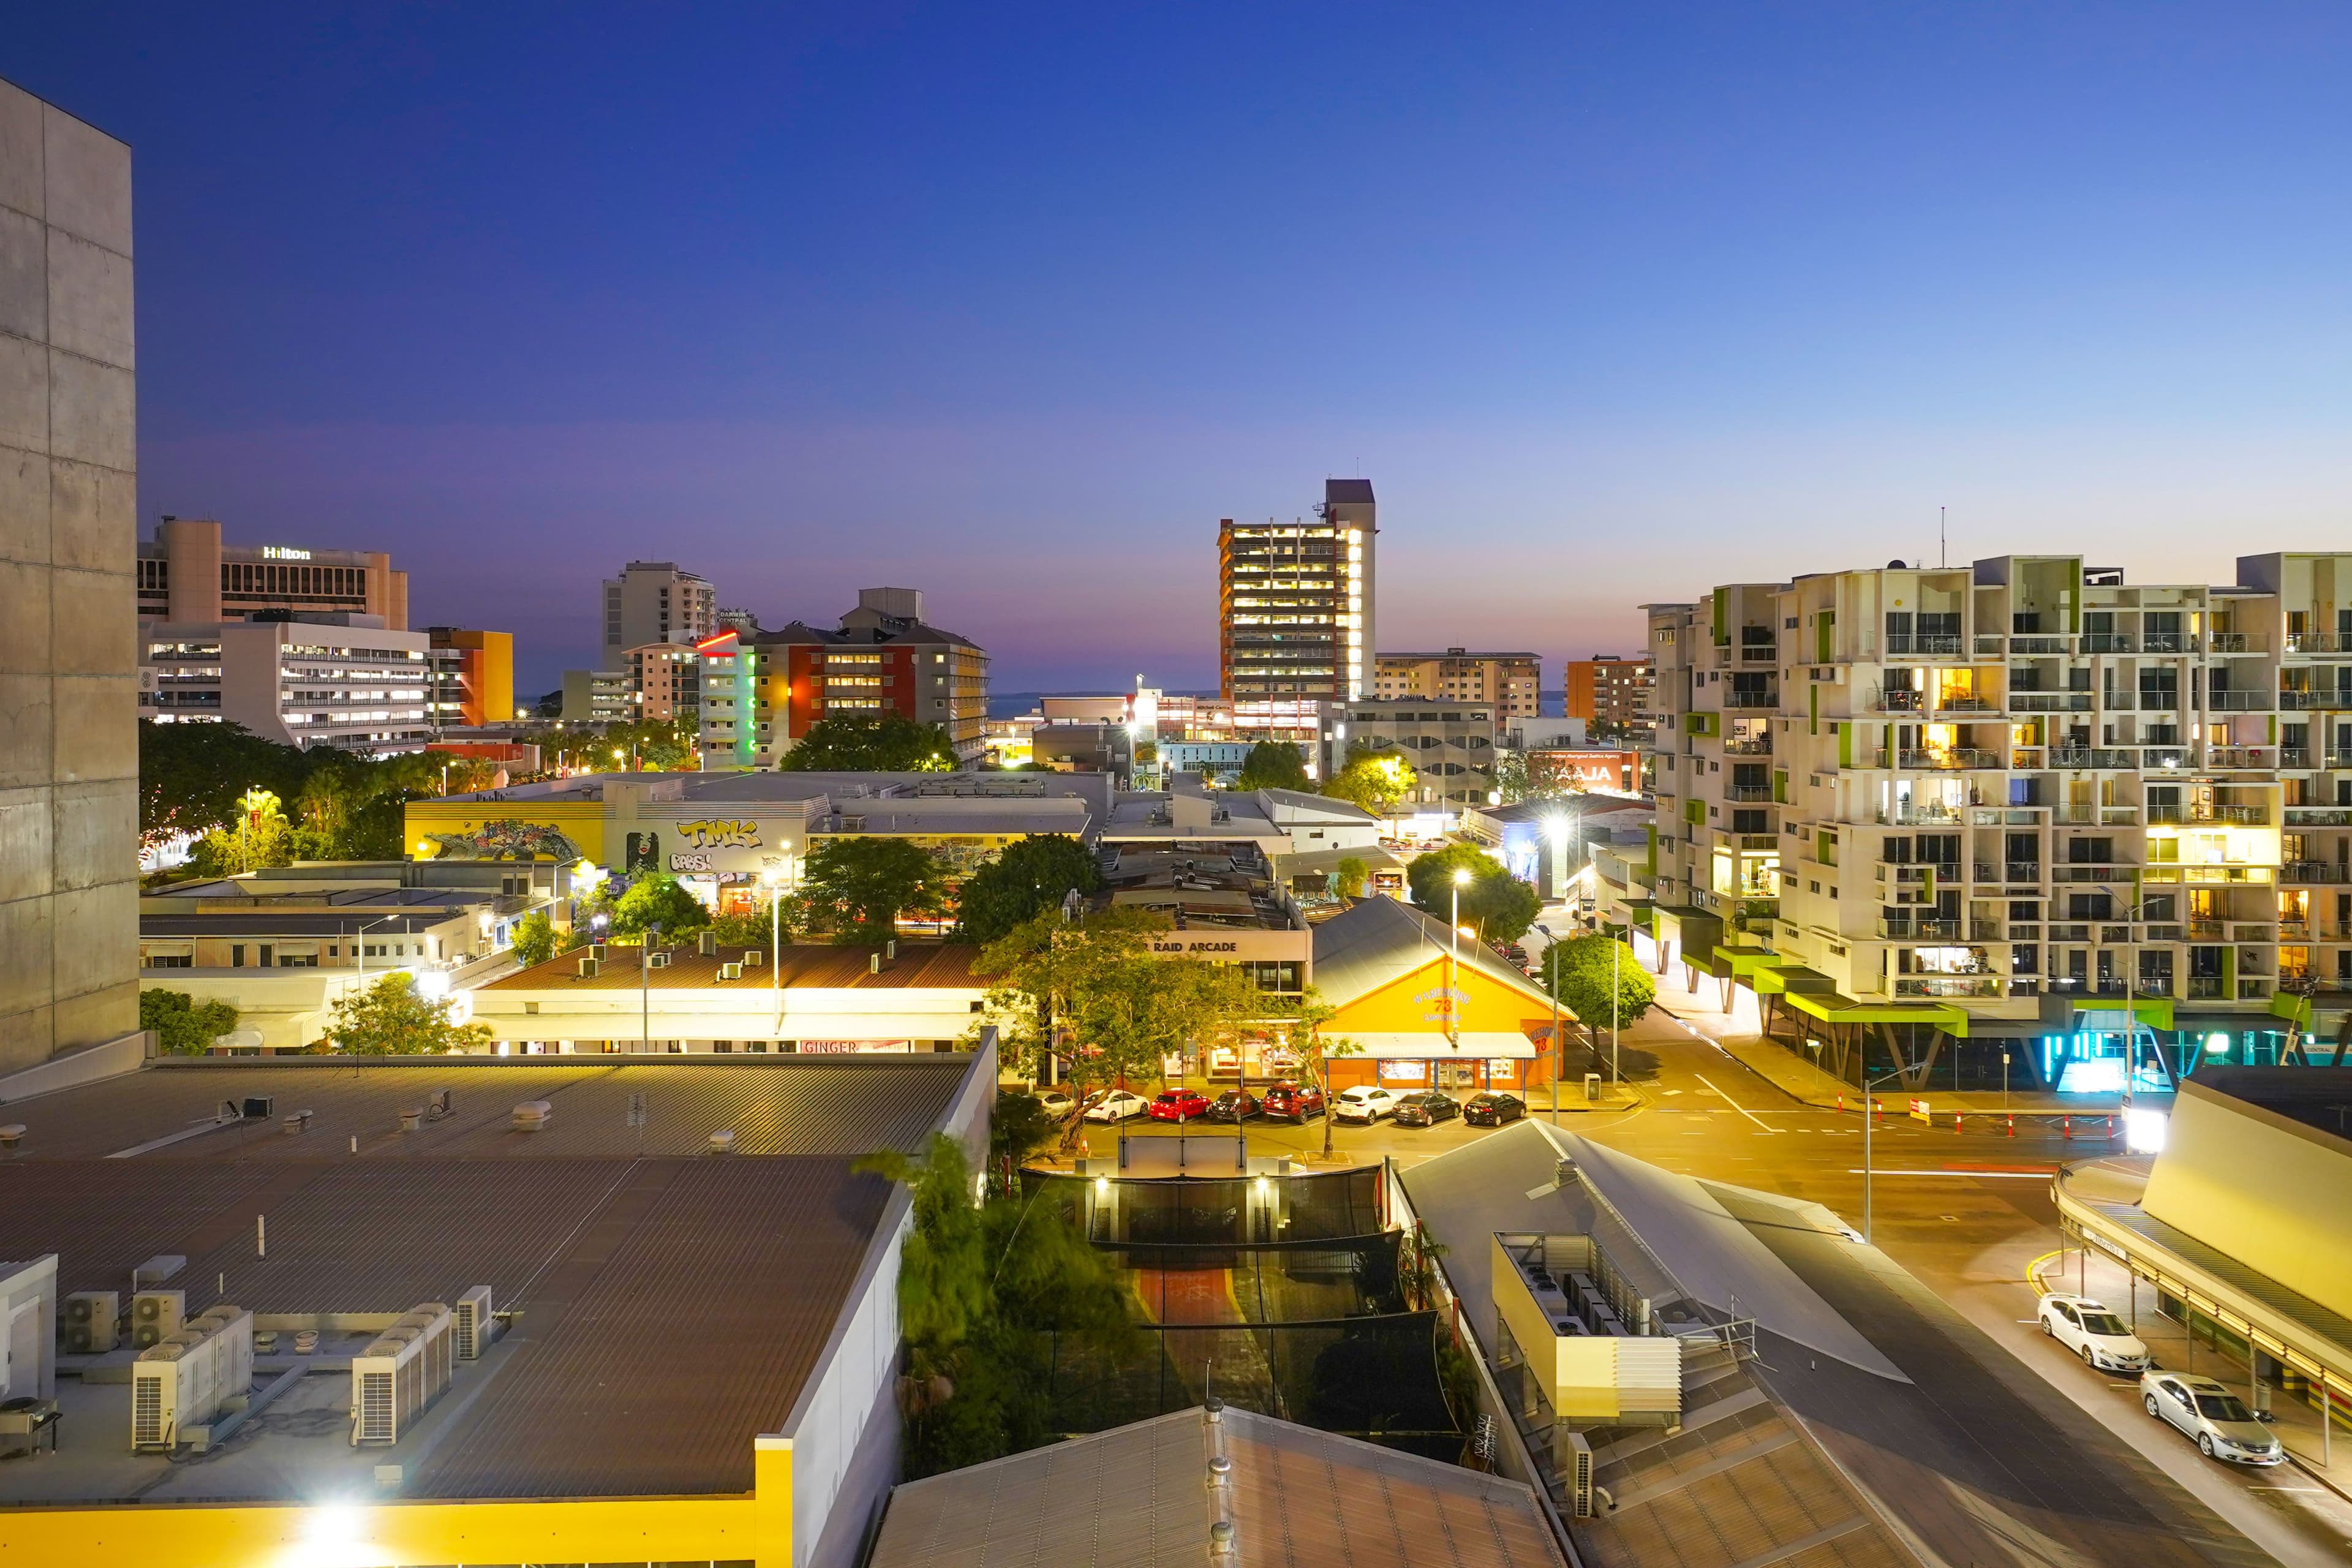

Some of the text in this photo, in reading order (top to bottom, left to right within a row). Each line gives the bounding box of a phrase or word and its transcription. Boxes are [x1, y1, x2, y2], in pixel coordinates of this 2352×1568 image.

[263, 546, 311, 560] Hilton
[676, 820, 763, 850] TMK
[1154, 943, 1183, 951] RAID
[1189, 943, 1237, 951] ARCADE
[1434, 1000, 1452, 1012] 73
[805, 1041, 856, 1054] GINGER
[1534, 1038, 1547, 1053] 73
